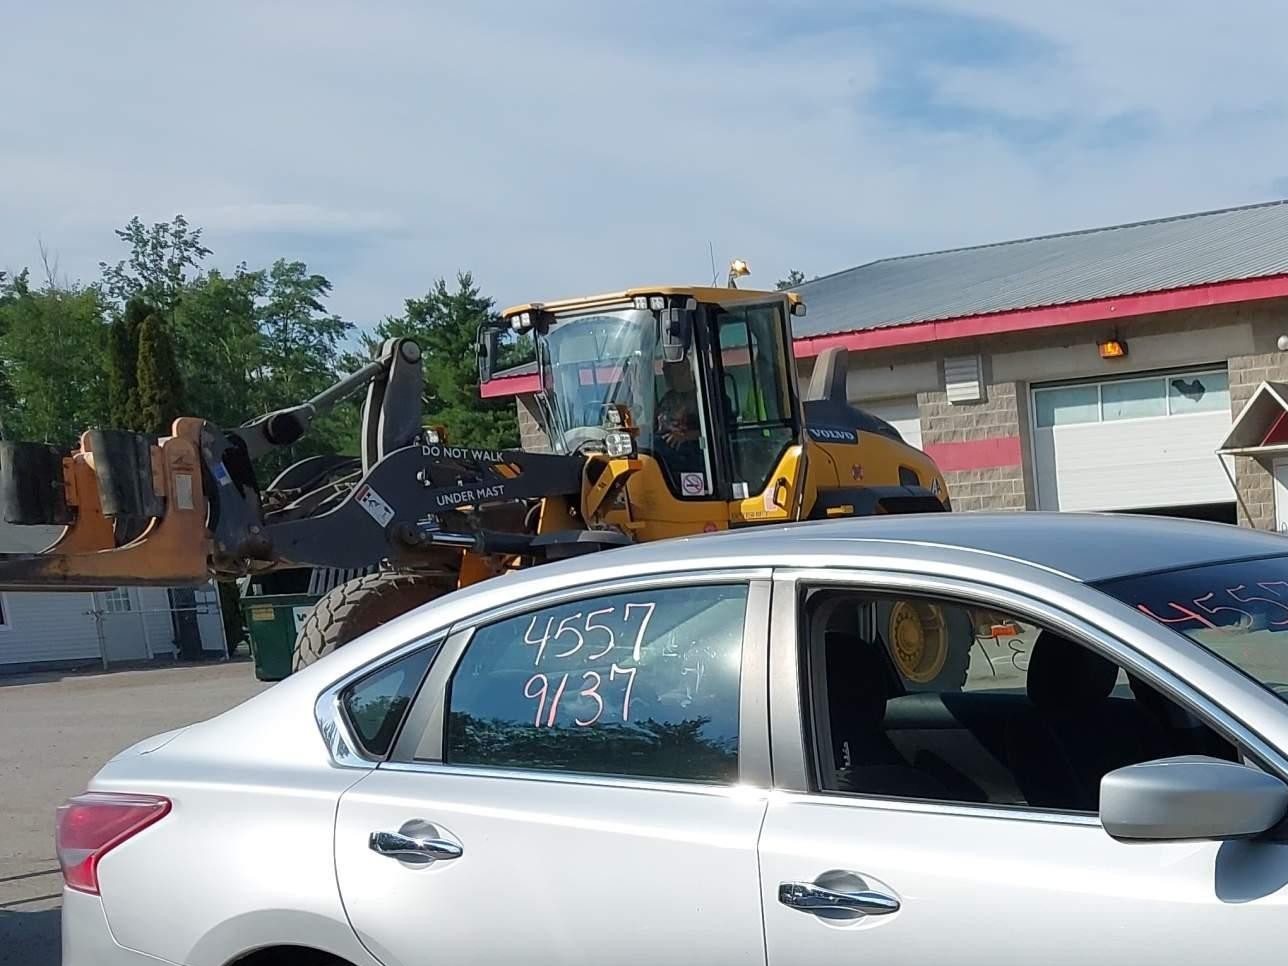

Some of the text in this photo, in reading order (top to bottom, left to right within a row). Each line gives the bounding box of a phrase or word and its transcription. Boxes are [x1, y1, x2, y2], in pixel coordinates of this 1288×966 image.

[810, 428, 855, 441] VOLVO
[422, 445, 504, 462] DO NOT WALK
[436, 485, 504, 506] UNDER MAST
[523, 602, 656, 666] 4557
[523, 663, 637, 728] 9137
